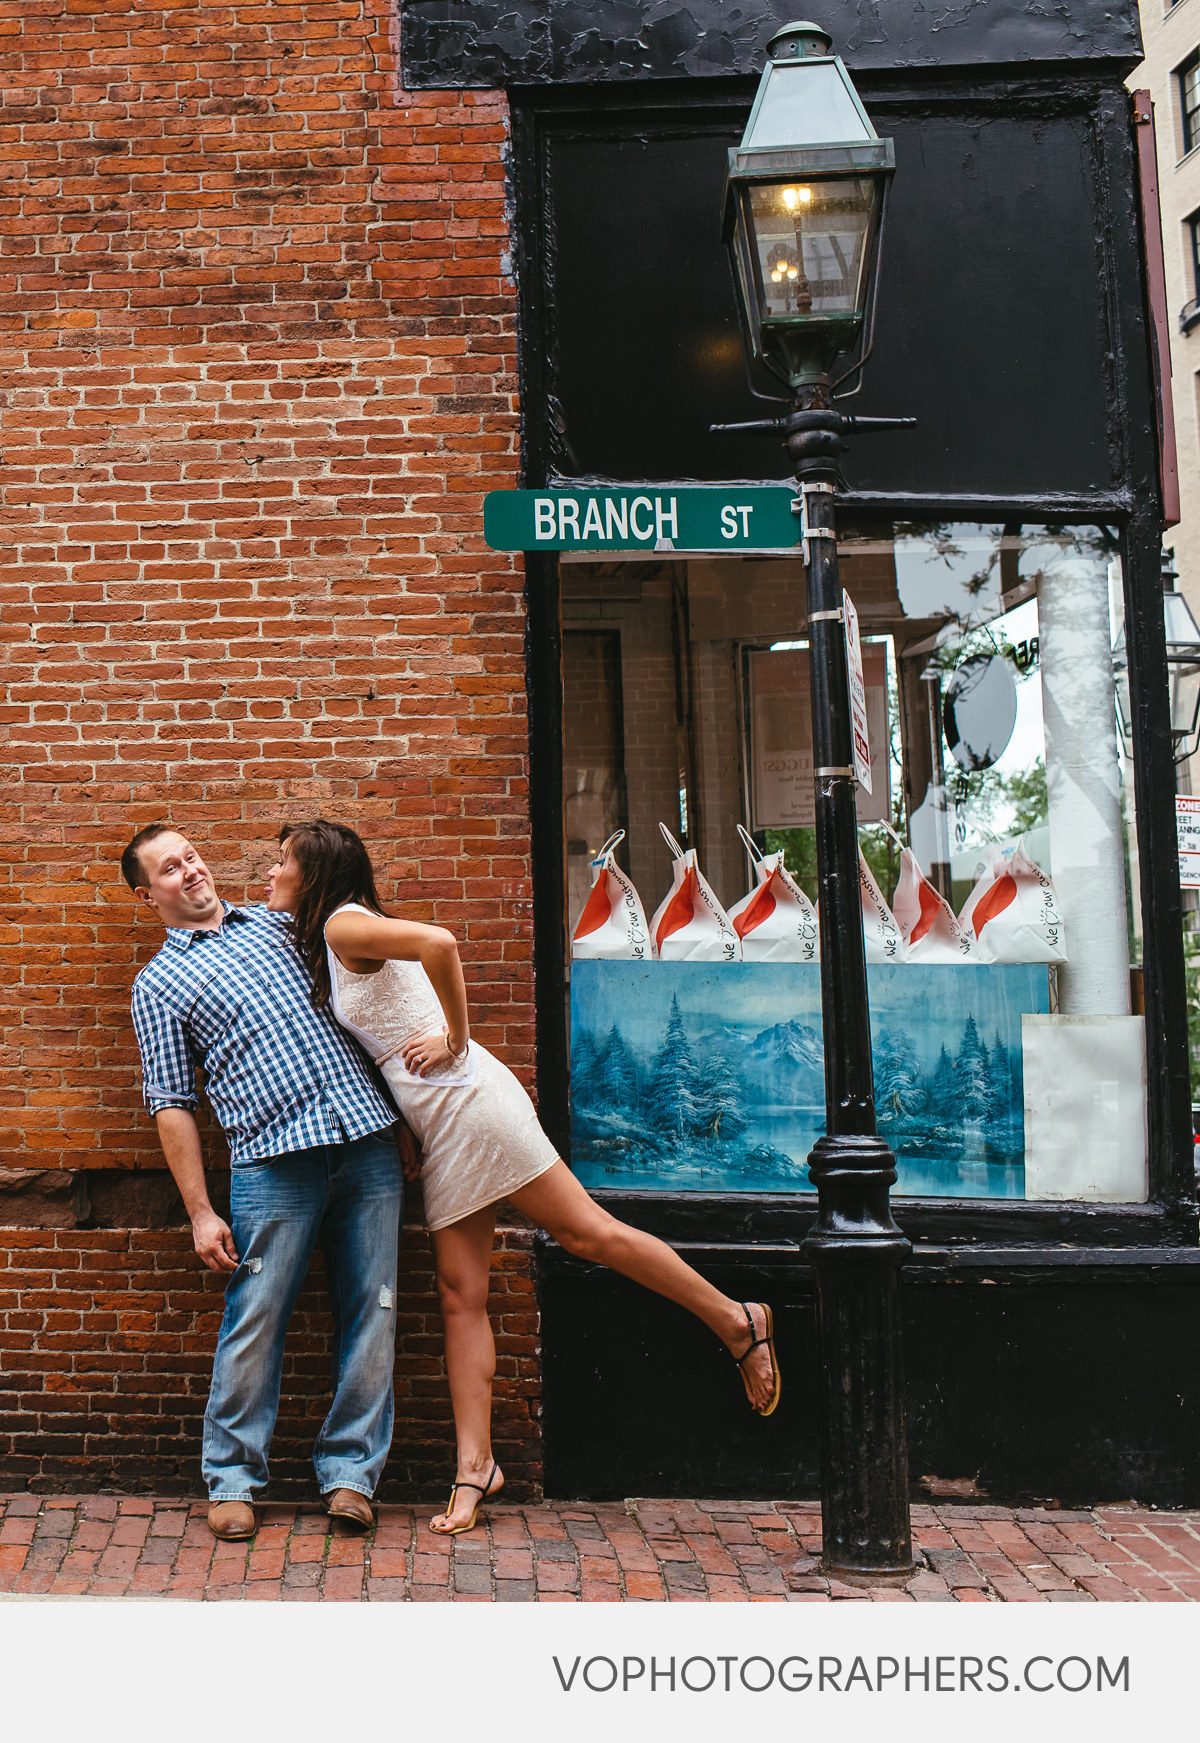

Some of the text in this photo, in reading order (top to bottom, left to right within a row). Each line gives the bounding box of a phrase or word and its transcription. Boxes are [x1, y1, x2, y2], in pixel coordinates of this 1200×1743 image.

[534, 496, 753, 541] BRANCH ST
[1177, 815, 1192, 825] EET
[1046, 927, 1059, 947] We
[722, 943, 735, 961] We
[802, 942, 815, 960] We
[884, 939, 897, 957] We
[959, 938, 971, 955] We
